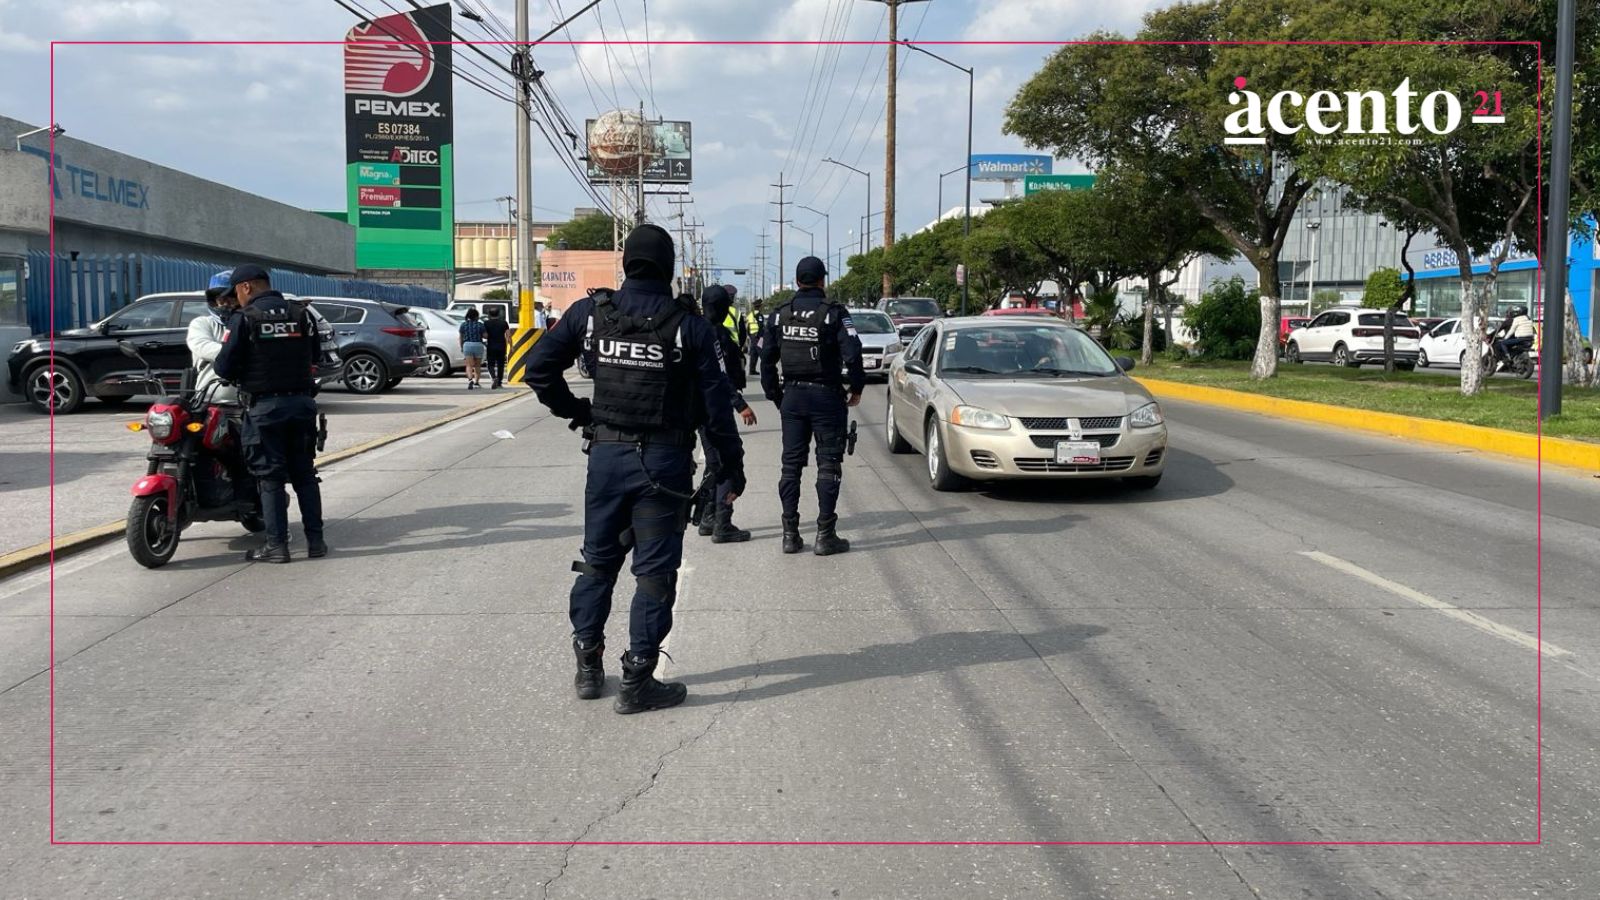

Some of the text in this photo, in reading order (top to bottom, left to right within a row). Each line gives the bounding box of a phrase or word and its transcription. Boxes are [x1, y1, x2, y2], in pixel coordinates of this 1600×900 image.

[354, 99, 440, 117] PEMEX
[378, 122, 420, 135] ES 07384
[979, 161, 1028, 172] Walmart
[360, 169, 389, 181] Magna
[65, 164, 149, 210] TELMEX
[360, 192, 394, 201] Premium
[542, 271, 576, 282] CARNITAS
[261, 322, 298, 334] DRT
[782, 325, 818, 337] UFES
[599, 340, 664, 361] UFES
